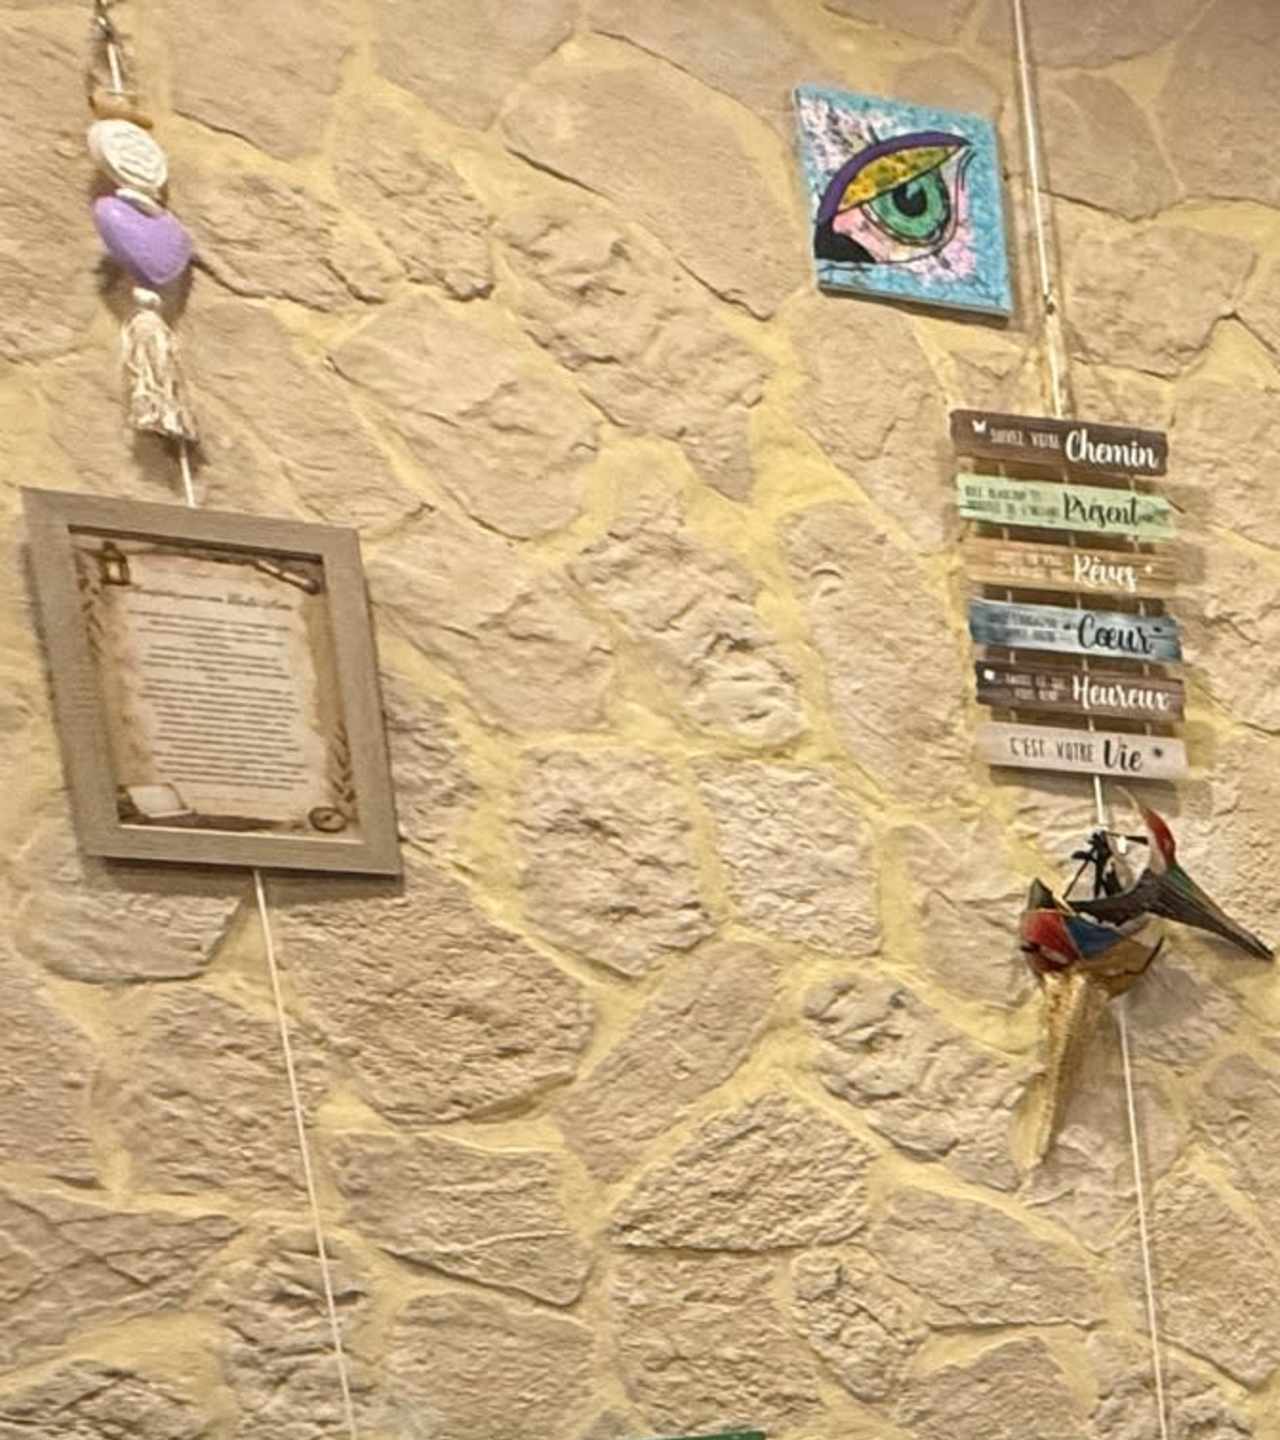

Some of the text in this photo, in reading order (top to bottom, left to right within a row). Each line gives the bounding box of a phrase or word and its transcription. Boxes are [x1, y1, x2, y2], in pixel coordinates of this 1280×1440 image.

[1064, 428, 1160, 469] Chemin
[1062, 491, 1140, 529] Présent
[1072, 554, 1138, 593] Rêves
[1077, 612, 1154, 655] Cœur
[1072, 674, 1171, 712] Heureux
[1009, 736, 1143, 773] C'EST VOTRE Vie
